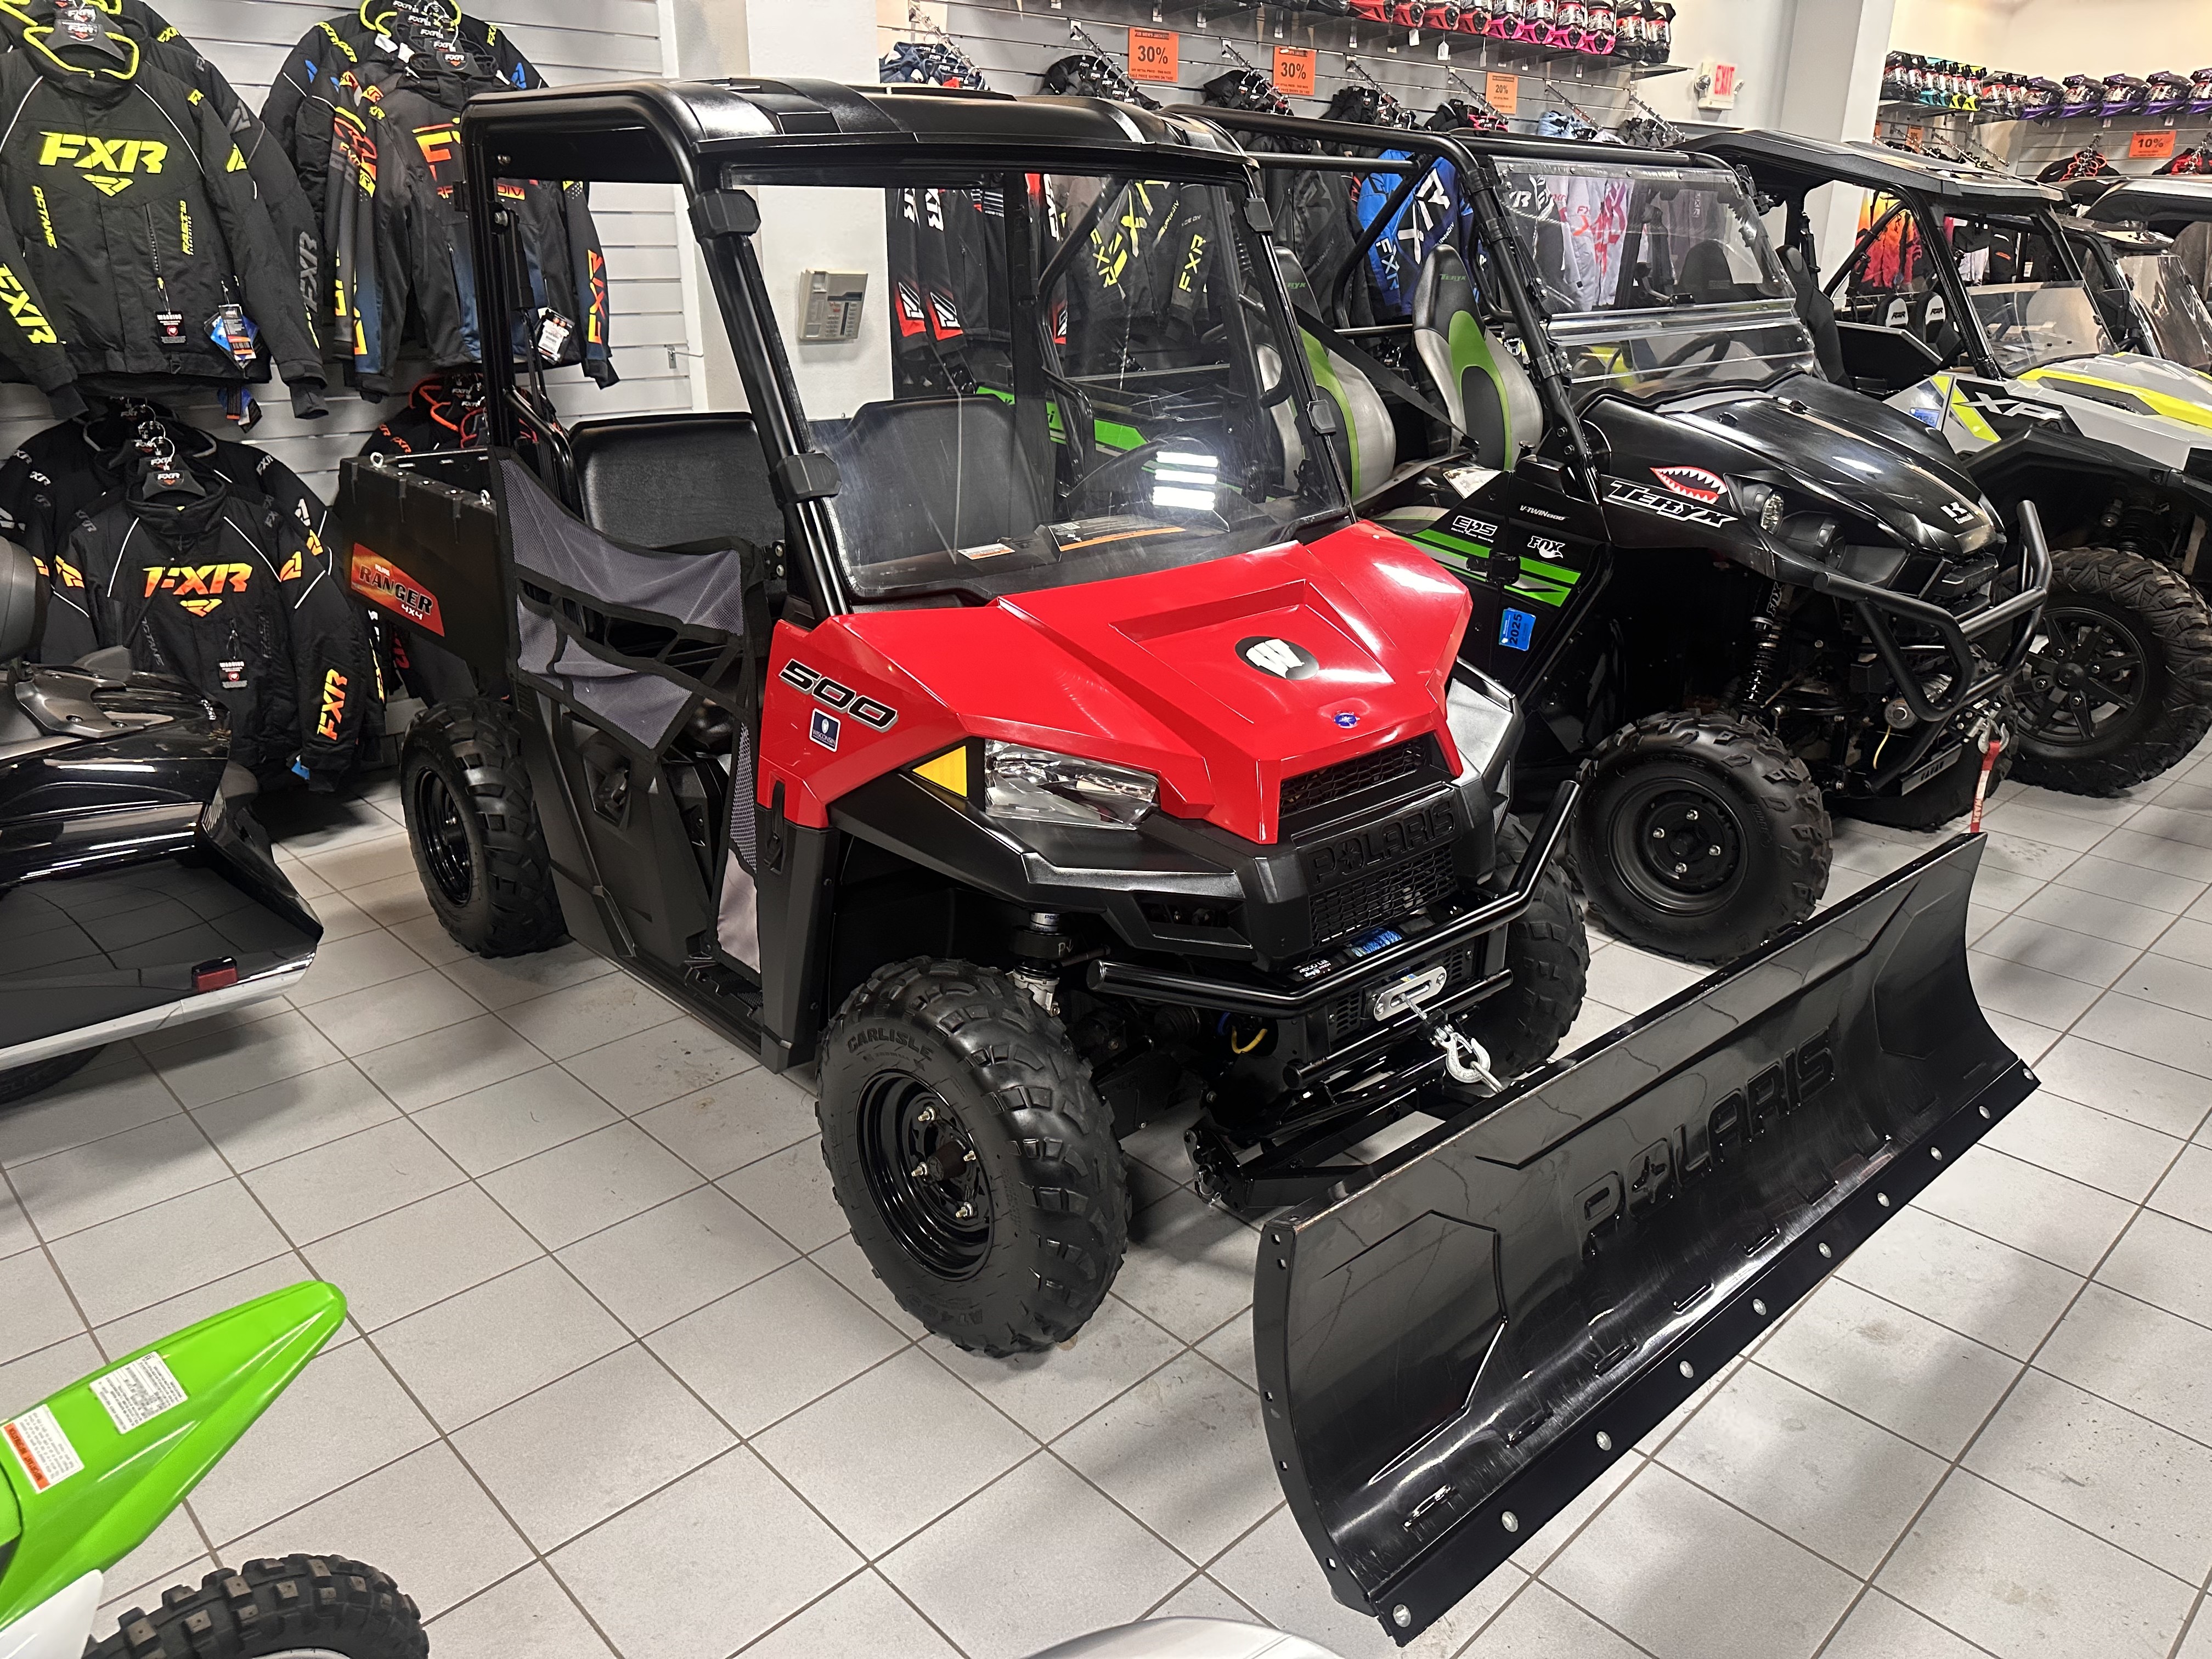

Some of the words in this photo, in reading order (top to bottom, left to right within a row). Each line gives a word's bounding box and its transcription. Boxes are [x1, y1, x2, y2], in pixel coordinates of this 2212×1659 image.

[1138, 45, 1168, 65] 30%
[1280, 61, 1306, 80] 30%
[1496, 84, 1508, 94] 20%
[1714, 64, 1735, 96] EXIT
[38, 131, 169, 174] FXR
[2138, 138, 2163, 148] 10%
[32, 185, 58, 249] OCTANE
[299, 231, 319, 313] FXR
[1178, 234, 1206, 293] FXR
[1375, 238, 1400, 290] FXR
[0, 263, 57, 343] FXR
[588, 249, 604, 345] FXR
[1527, 535, 1566, 552] FOX
[143, 563, 253, 598] FXR
[359, 565, 433, 616] RANGER
[1509, 613, 1522, 646] 2025
[317, 669, 348, 741] FXR
[778, 658, 899, 731] 500
[812, 729, 836, 746] WISCONSIN
[1972, 798, 1983, 823] WARN
[1307, 800, 1455, 885] POLARIS
[847, 1028, 934, 1062] CARLISLE
[1573, 1025, 1836, 1261] POLARIS
